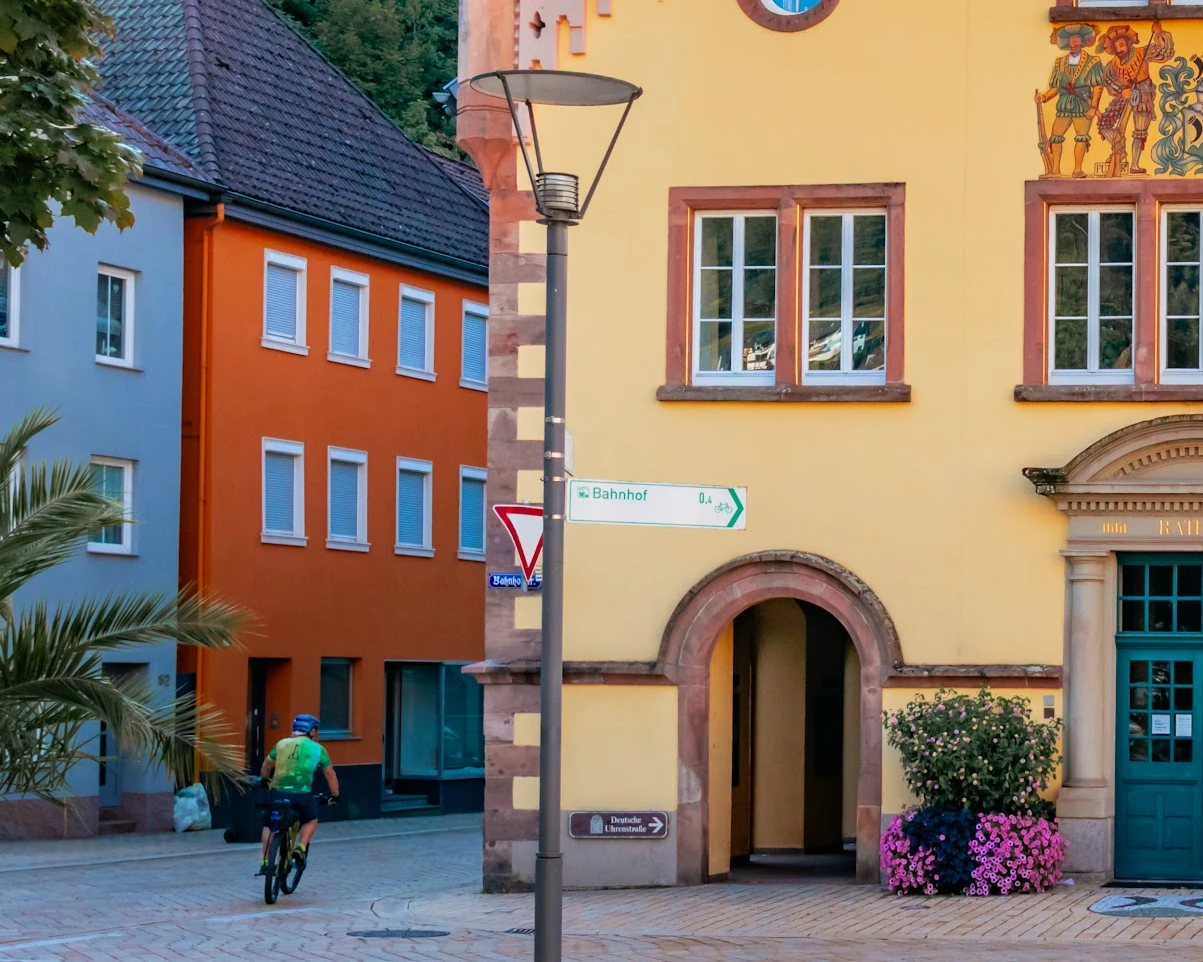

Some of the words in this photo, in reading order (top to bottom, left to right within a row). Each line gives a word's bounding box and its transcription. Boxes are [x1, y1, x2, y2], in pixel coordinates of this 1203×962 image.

[593, 487, 648, 501] Bahnhof
[611, 816, 642, 825] Deutsche
[605, 824, 647, 833] Uhrenstraße
